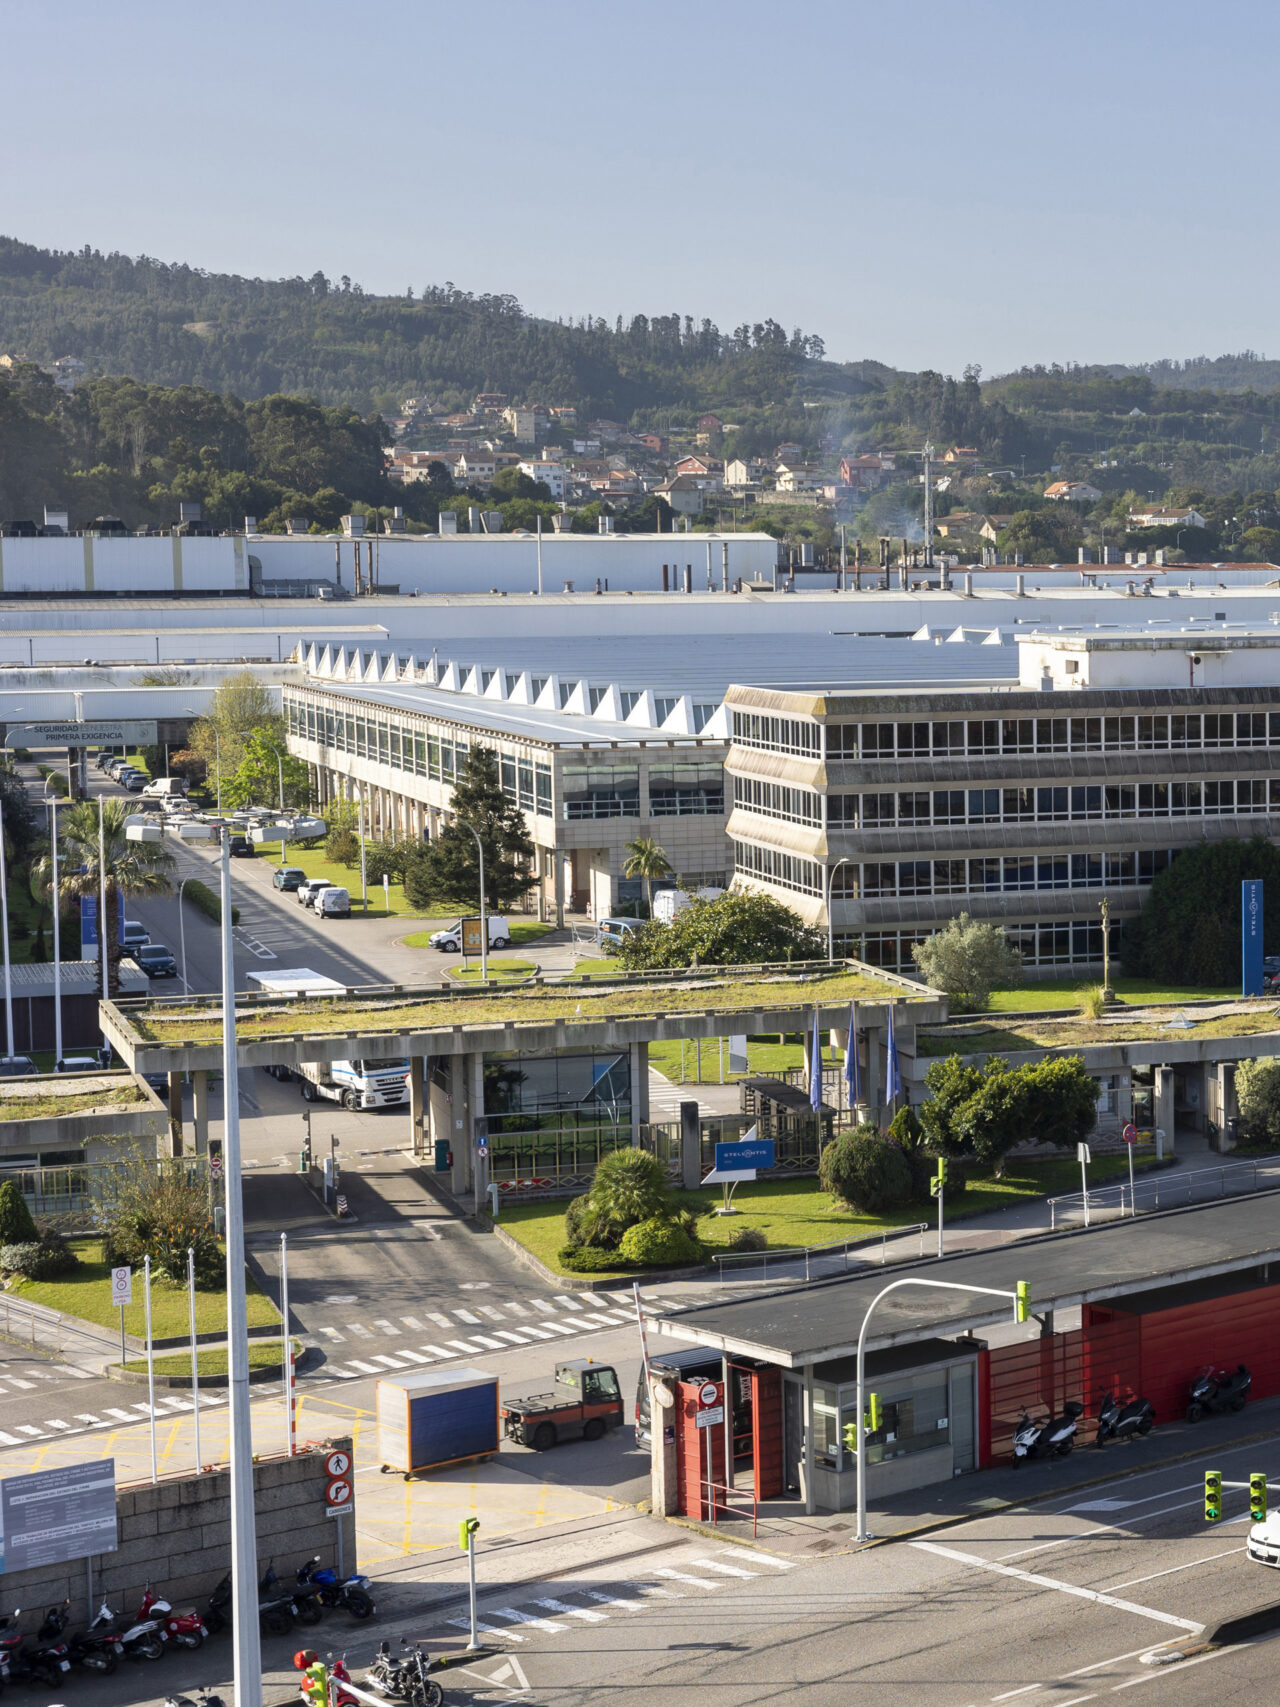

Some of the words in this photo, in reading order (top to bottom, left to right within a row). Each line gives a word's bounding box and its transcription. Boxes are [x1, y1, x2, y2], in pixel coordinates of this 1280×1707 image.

[34, 725, 79, 733] SEGURIDAD
[46, 733, 80, 741] PRIMERA
[81, 732, 123, 740] EXIGENCIA
[1249, 884, 1259, 936] STELLANTIS
[723, 1149, 767, 1158] STELLANTIS
